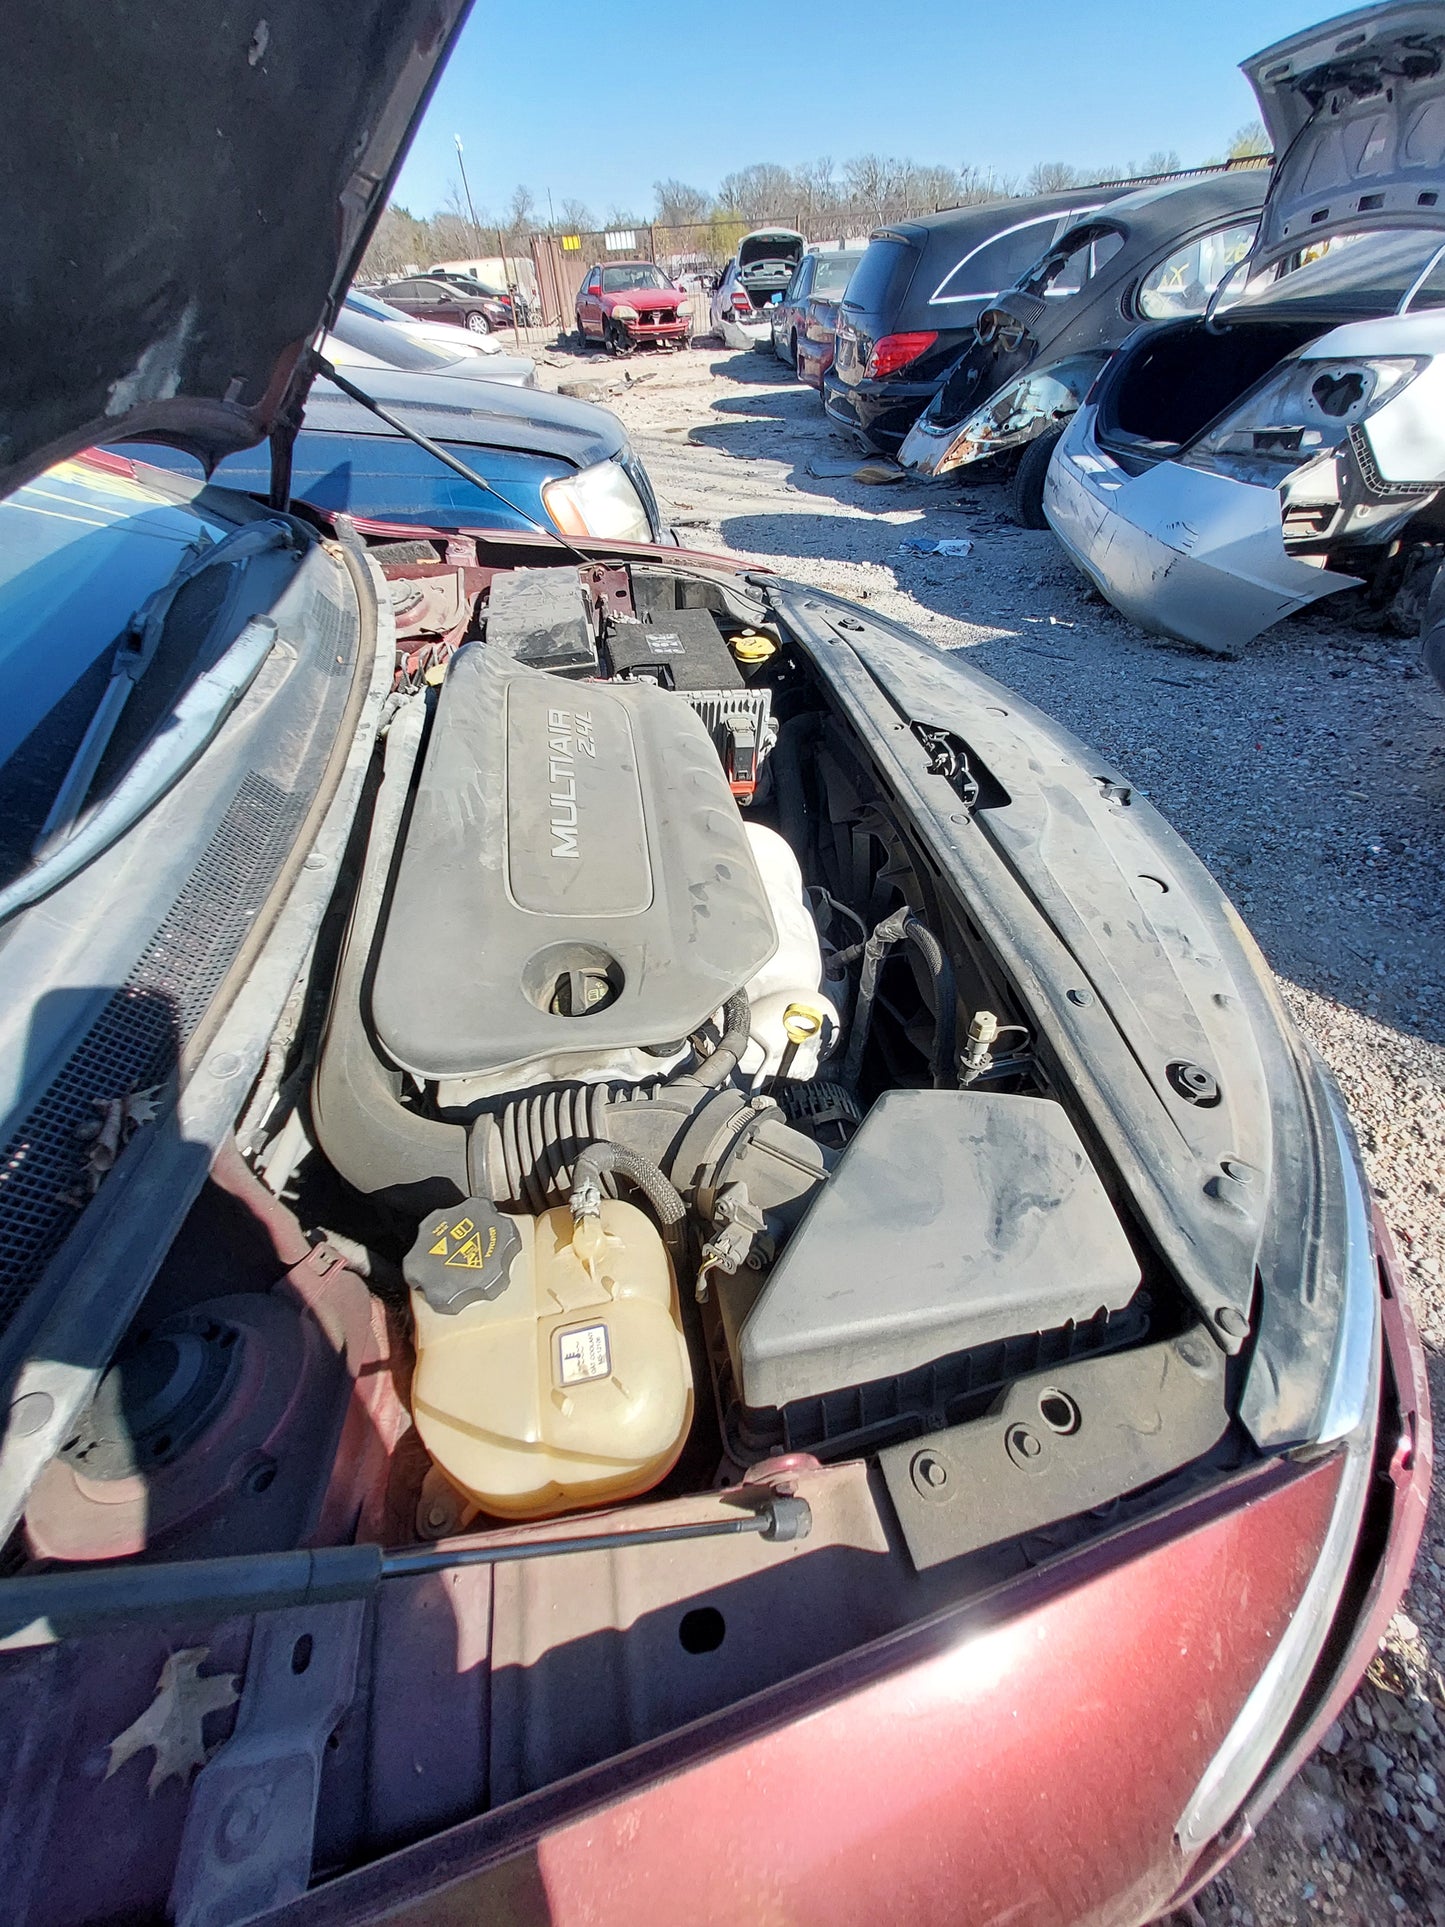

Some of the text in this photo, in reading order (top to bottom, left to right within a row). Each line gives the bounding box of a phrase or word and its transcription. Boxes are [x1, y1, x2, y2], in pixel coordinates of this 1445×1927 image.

[575, 711, 596, 759] 2.4L
[548, 709, 580, 859] MULTIAIR
[587, 1332, 596, 1361] COOLANT
